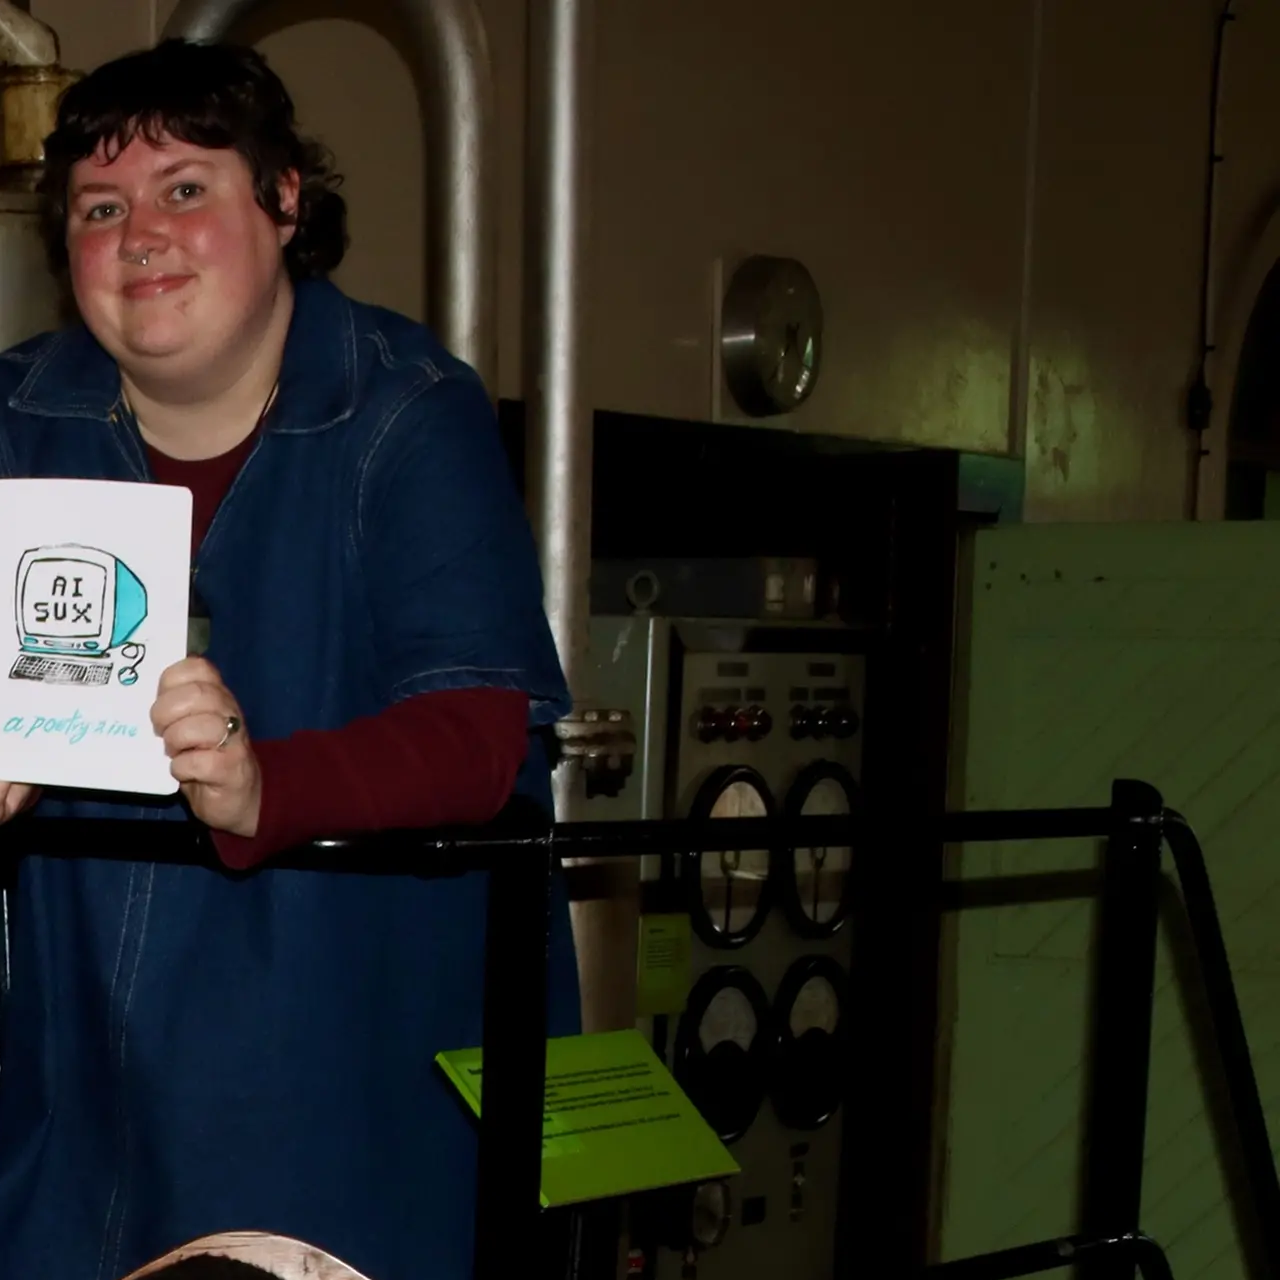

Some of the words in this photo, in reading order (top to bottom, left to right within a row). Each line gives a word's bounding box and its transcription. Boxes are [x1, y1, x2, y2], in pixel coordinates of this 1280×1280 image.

[51, 575, 83, 597] AI
[33, 602, 92, 623] SUX
[3, 716, 25, 732] a
[24, 708, 91, 744] poetry
[94, 719, 138, 737] zine
